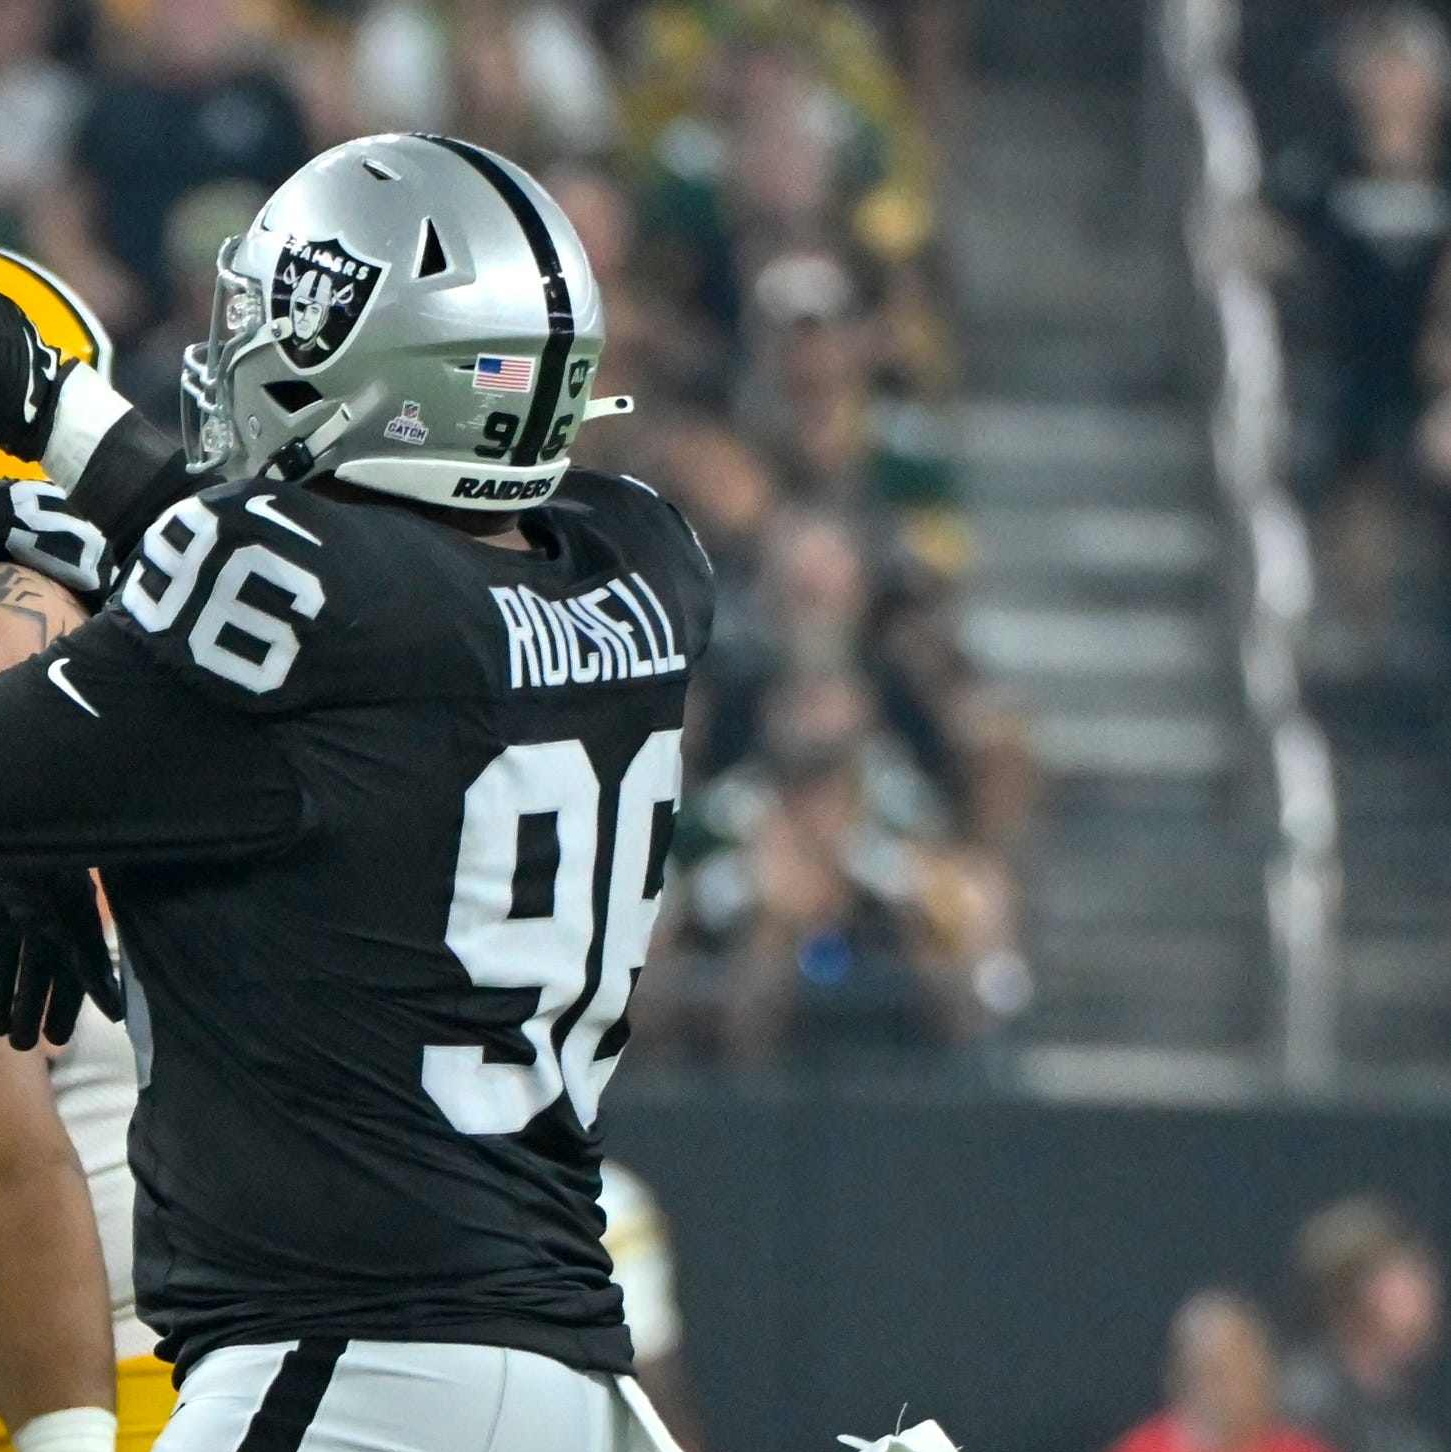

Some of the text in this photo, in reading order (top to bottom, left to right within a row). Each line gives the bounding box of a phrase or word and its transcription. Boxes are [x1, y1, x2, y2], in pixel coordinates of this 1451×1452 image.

[451, 476, 556, 500] RAIDERS
[121, 496, 326, 695] 96
[488, 572, 687, 690] ROCHELL
